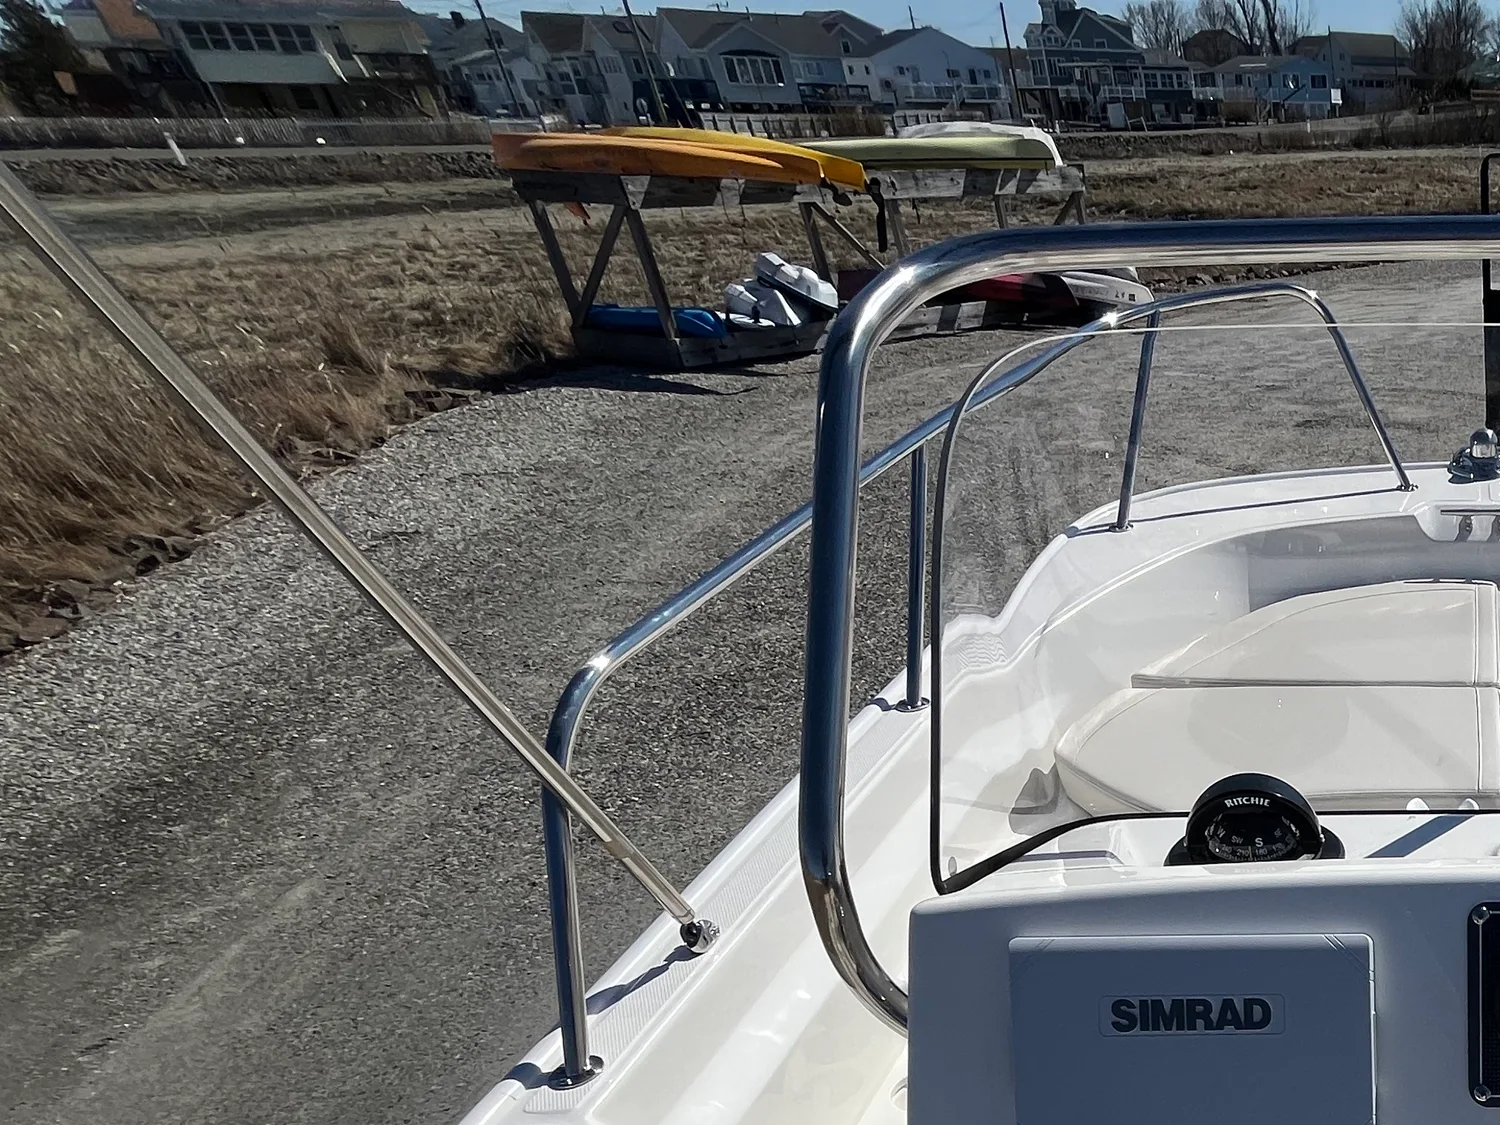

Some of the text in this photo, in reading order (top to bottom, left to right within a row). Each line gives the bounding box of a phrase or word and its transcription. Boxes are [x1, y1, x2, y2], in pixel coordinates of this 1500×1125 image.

[1224, 796, 1271, 808] RITCHIE
[1254, 837, 1264, 847] S
[1111, 998, 1272, 1032] SIMRAD
